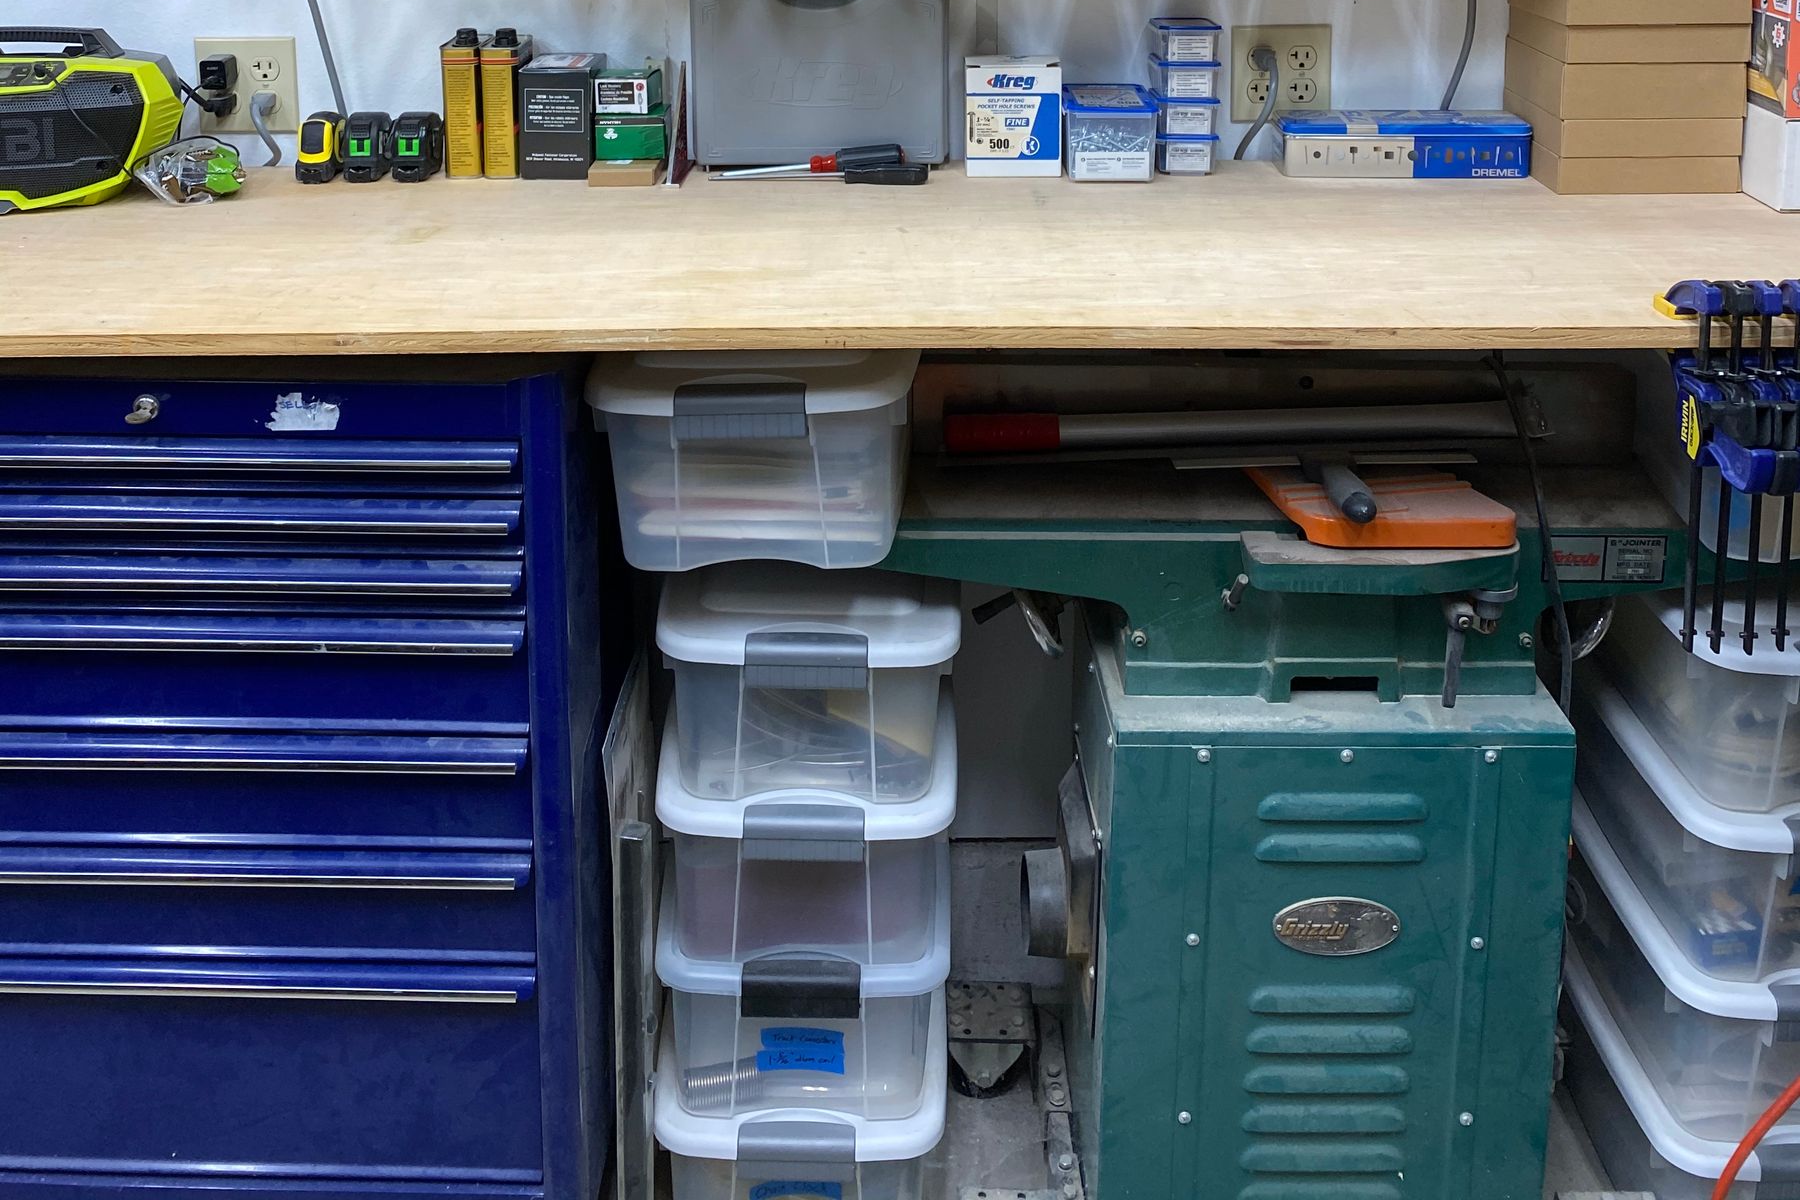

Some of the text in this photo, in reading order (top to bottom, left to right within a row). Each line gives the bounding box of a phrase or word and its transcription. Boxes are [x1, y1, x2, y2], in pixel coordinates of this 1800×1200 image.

[991, 73, 1036, 91] Kreg
[1005, 118, 1027, 126] FINE
[989, 138, 1010, 150] 500
[1472, 168, 1522, 177] DREMEL
[1680, 400, 1689, 443] IRWIN
[1623, 539, 1662, 547] JOINTER
[1279, 917, 1349, 941] Grizzly
